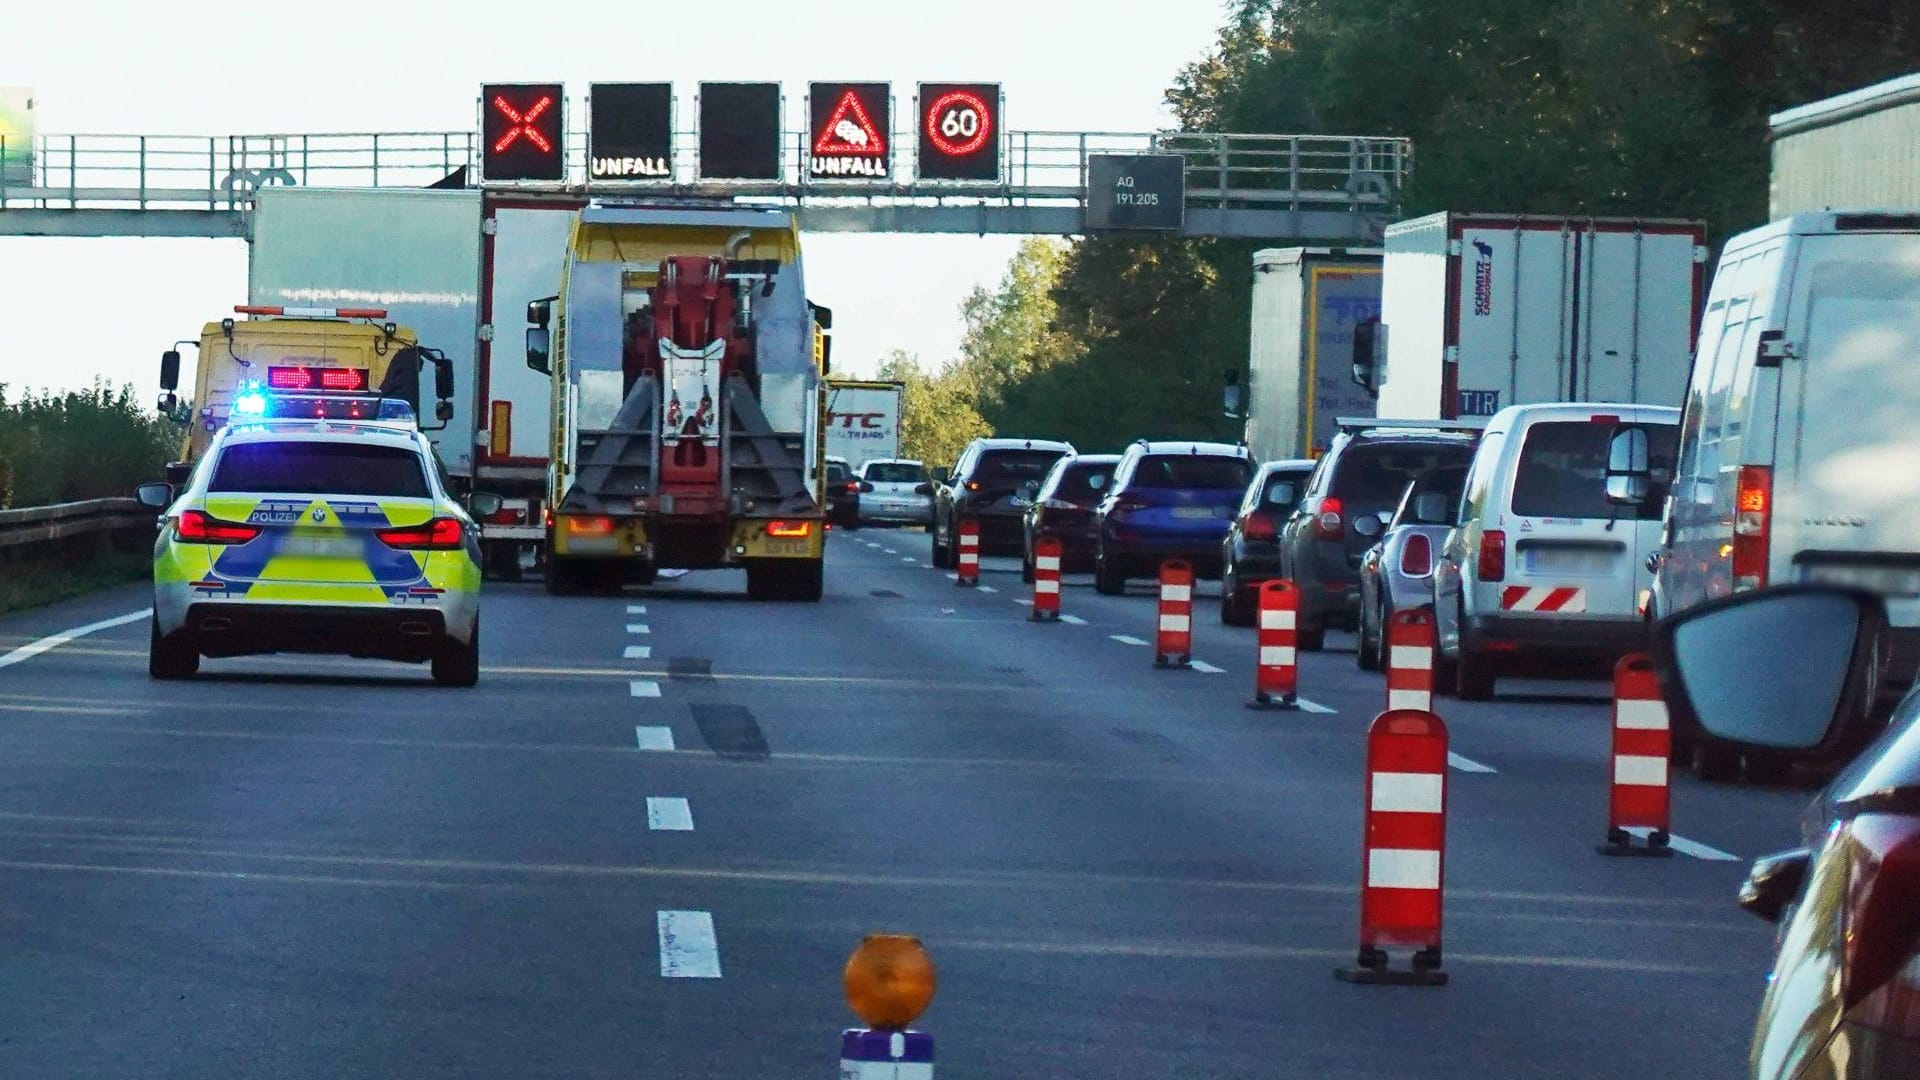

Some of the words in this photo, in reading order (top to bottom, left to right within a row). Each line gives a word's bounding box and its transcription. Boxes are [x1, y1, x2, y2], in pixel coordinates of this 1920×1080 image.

[942, 109, 978, 137] 60
[592, 156, 670, 176] UNFALL
[811, 156, 887, 177] UNFALL
[1116, 176, 1135, 188] AQ
[1116, 193, 1159, 206] 191.205
[1474, 260, 1484, 316] SCHMITZ
[1462, 391, 1496, 414] TIR
[252, 511, 296, 522] POLIZEI
